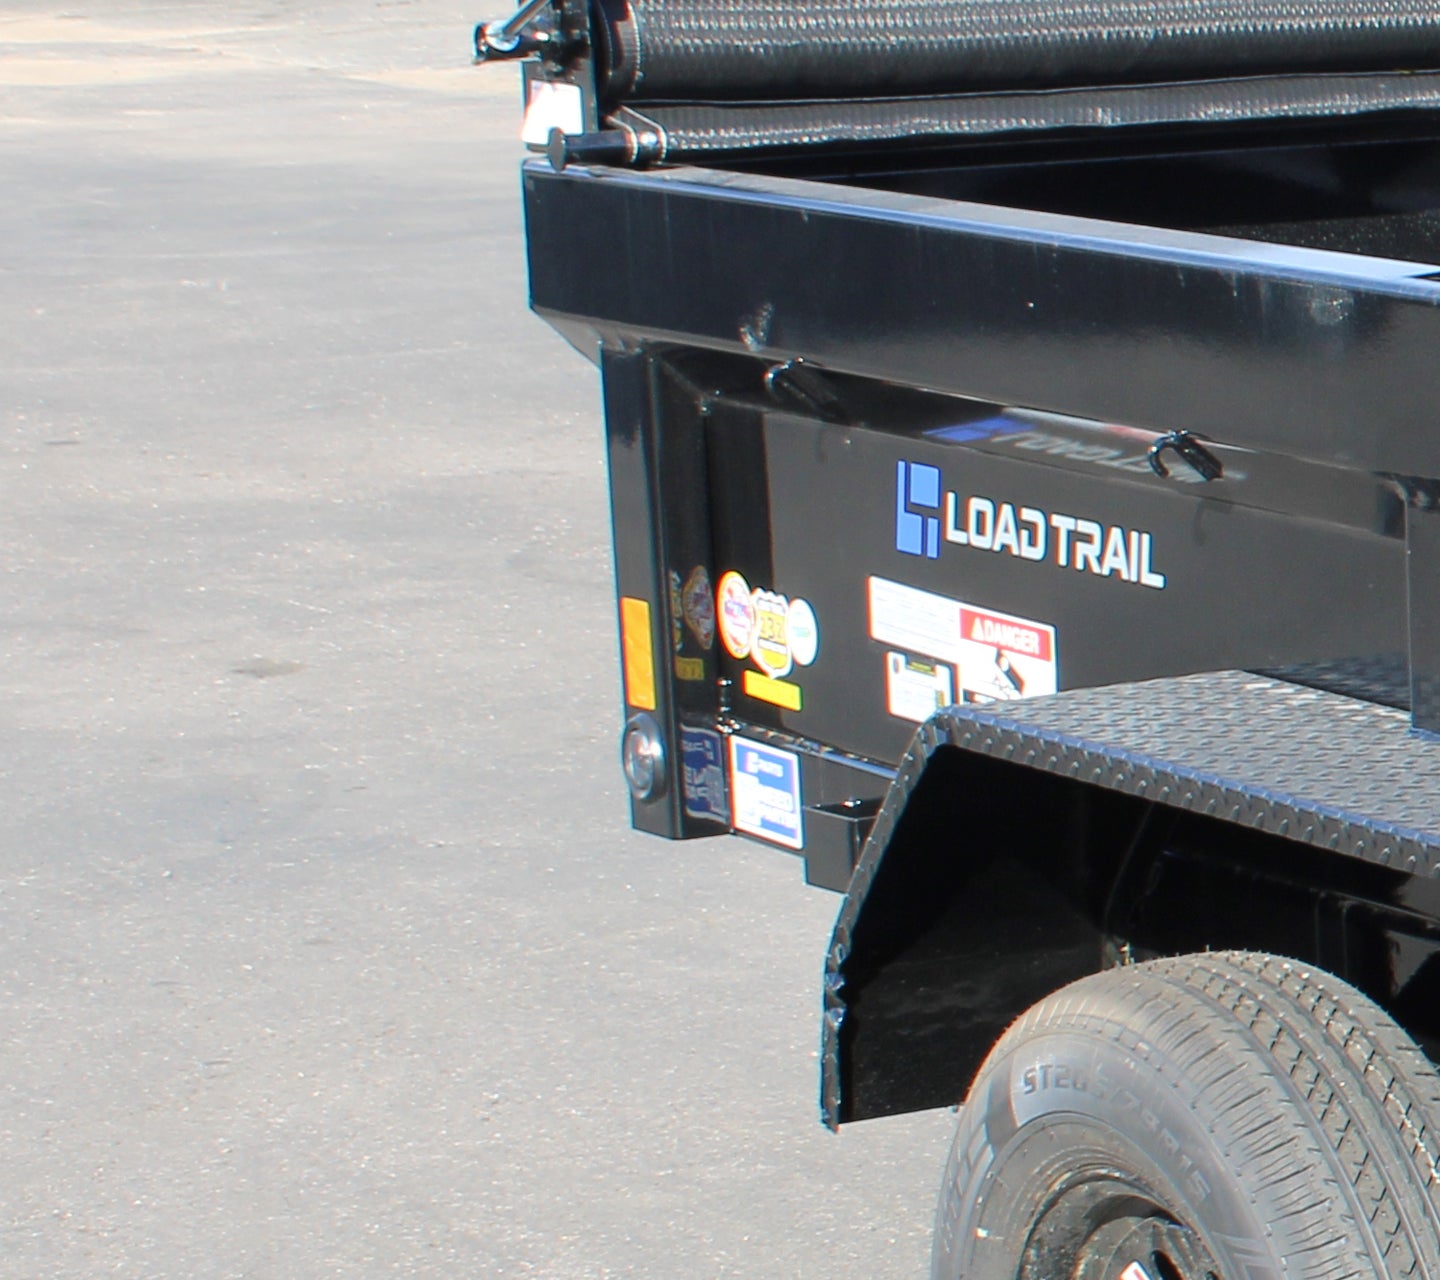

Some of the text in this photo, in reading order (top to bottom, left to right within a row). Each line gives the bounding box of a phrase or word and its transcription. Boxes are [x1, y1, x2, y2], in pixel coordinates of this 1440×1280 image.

[943, 490, 1167, 590] LOAD TRAIL
[983, 618, 1040, 656] DANGER
